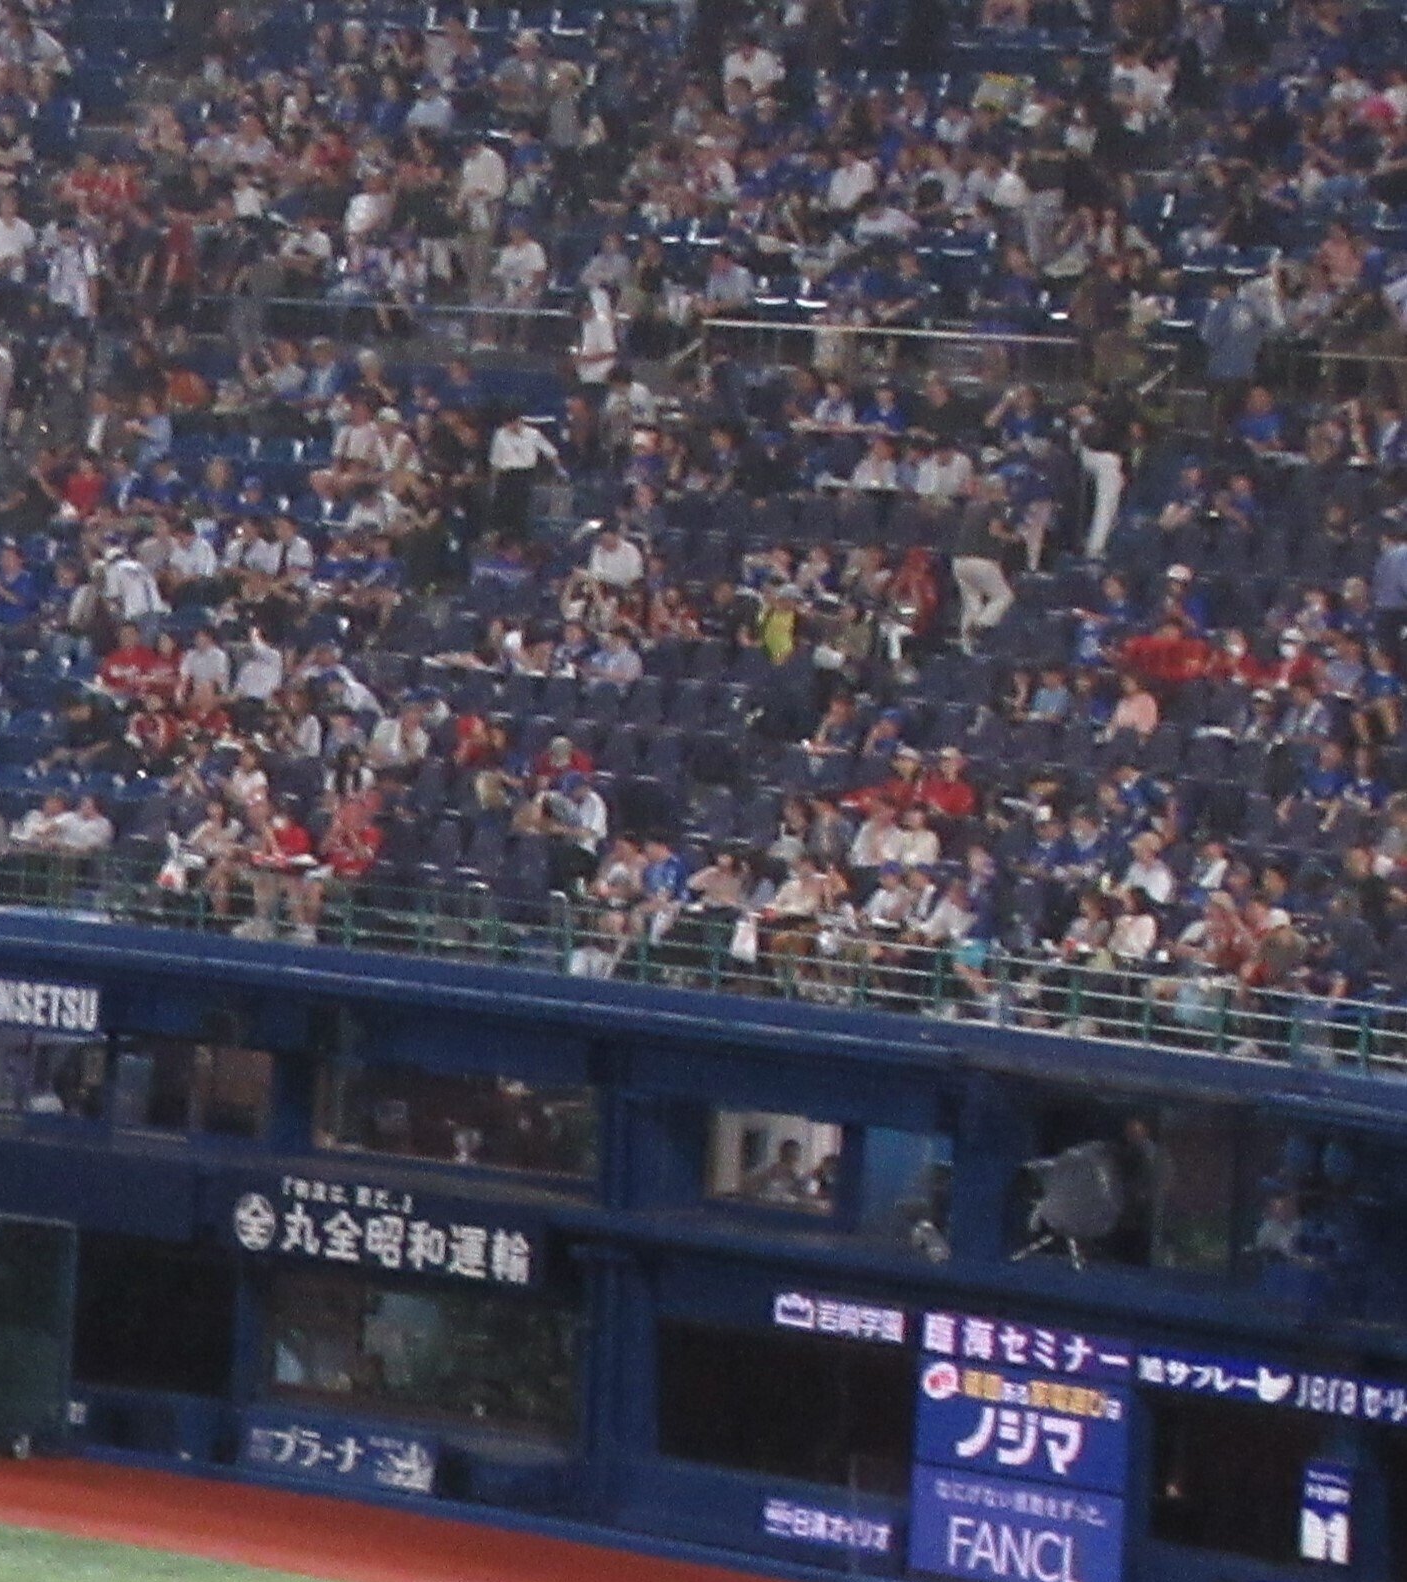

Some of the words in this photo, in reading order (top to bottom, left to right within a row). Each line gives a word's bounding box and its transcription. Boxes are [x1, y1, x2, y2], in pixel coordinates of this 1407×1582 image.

[280, 1202, 530, 1285] 丸全昭和運輸
[956, 1406, 1083, 1475] ノジマ
